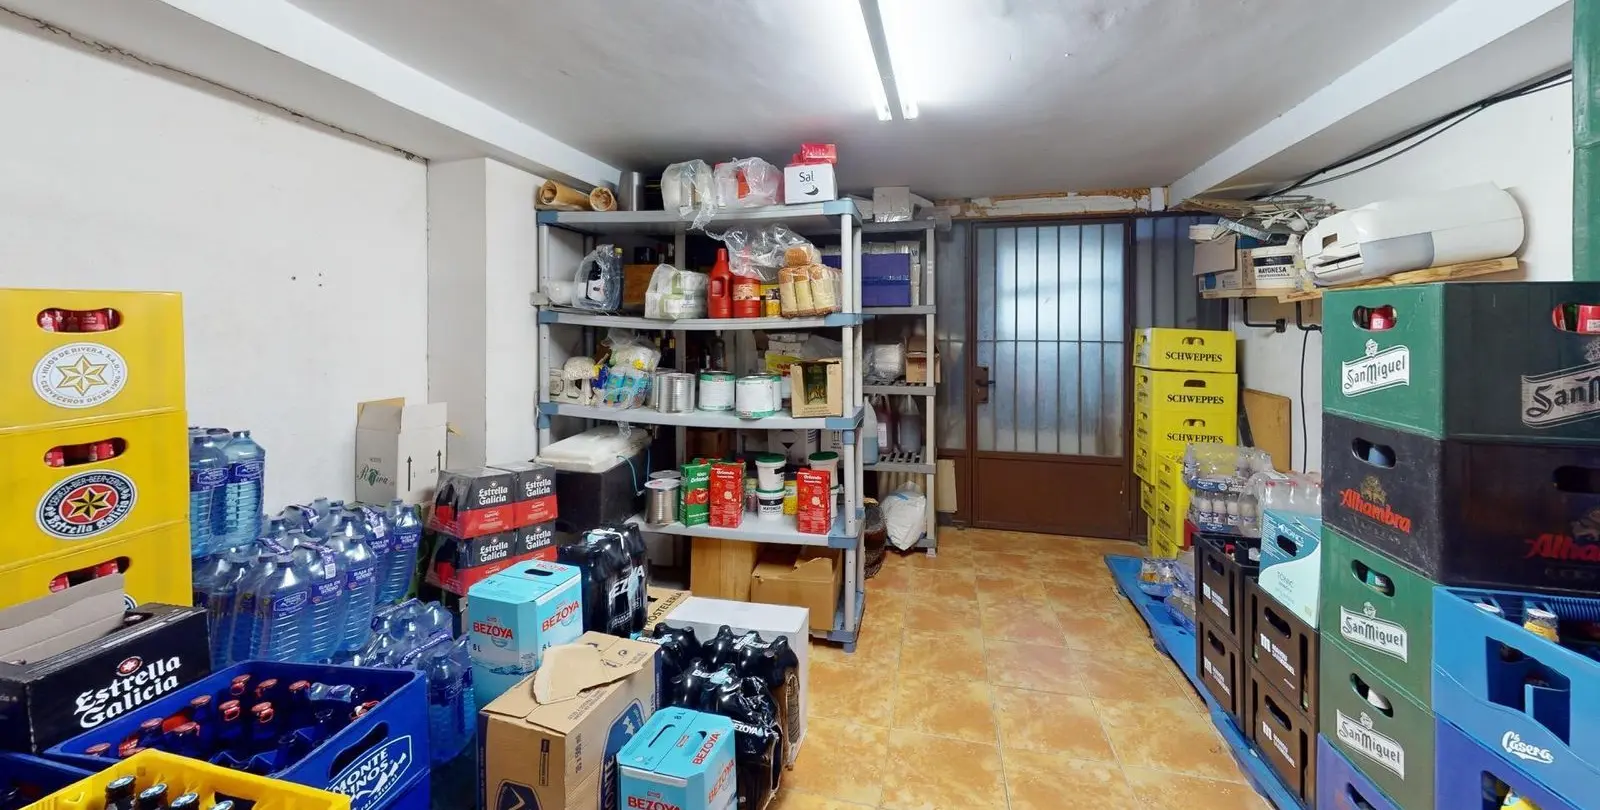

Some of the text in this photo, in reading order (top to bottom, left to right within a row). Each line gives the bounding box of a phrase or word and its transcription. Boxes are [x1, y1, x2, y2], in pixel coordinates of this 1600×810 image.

[799, 171, 814, 182] Sal
[43, 356, 58, 375] HIJOS
[59, 350, 70, 358] DE
[1165, 351, 1222, 363] SCHWEPPES
[41, 380, 84, 404] CERVECEROS
[87, 389, 110, 403] DESDE
[1167, 394, 1224, 405] SCHWEPPES
[1166, 433, 1223, 444] SCHWEPPES
[525, 479, 552, 489] Estrella
[479, 486, 508, 497] Estrella
[526, 486, 551, 497] Galicia
[479, 494, 507, 505] Galicia
[47, 500, 129, 534] Estrella Galicia
[1339, 488, 1411, 535] Alhambra
[525, 530, 552, 542] Estrella
[480, 541, 509, 554] Estrella
[526, 538, 551, 550] Galicia
[480, 550, 507, 562] Galicia
[542, 600, 580, 632] BEZOYA
[473, 621, 513, 640] BEZOYA
[74, 656, 182, 715] Estrella
[80, 675, 180, 728] Galicia
[692, 732, 720, 765] BEZOYA
[708, 759, 735, 804] BEZOYA
